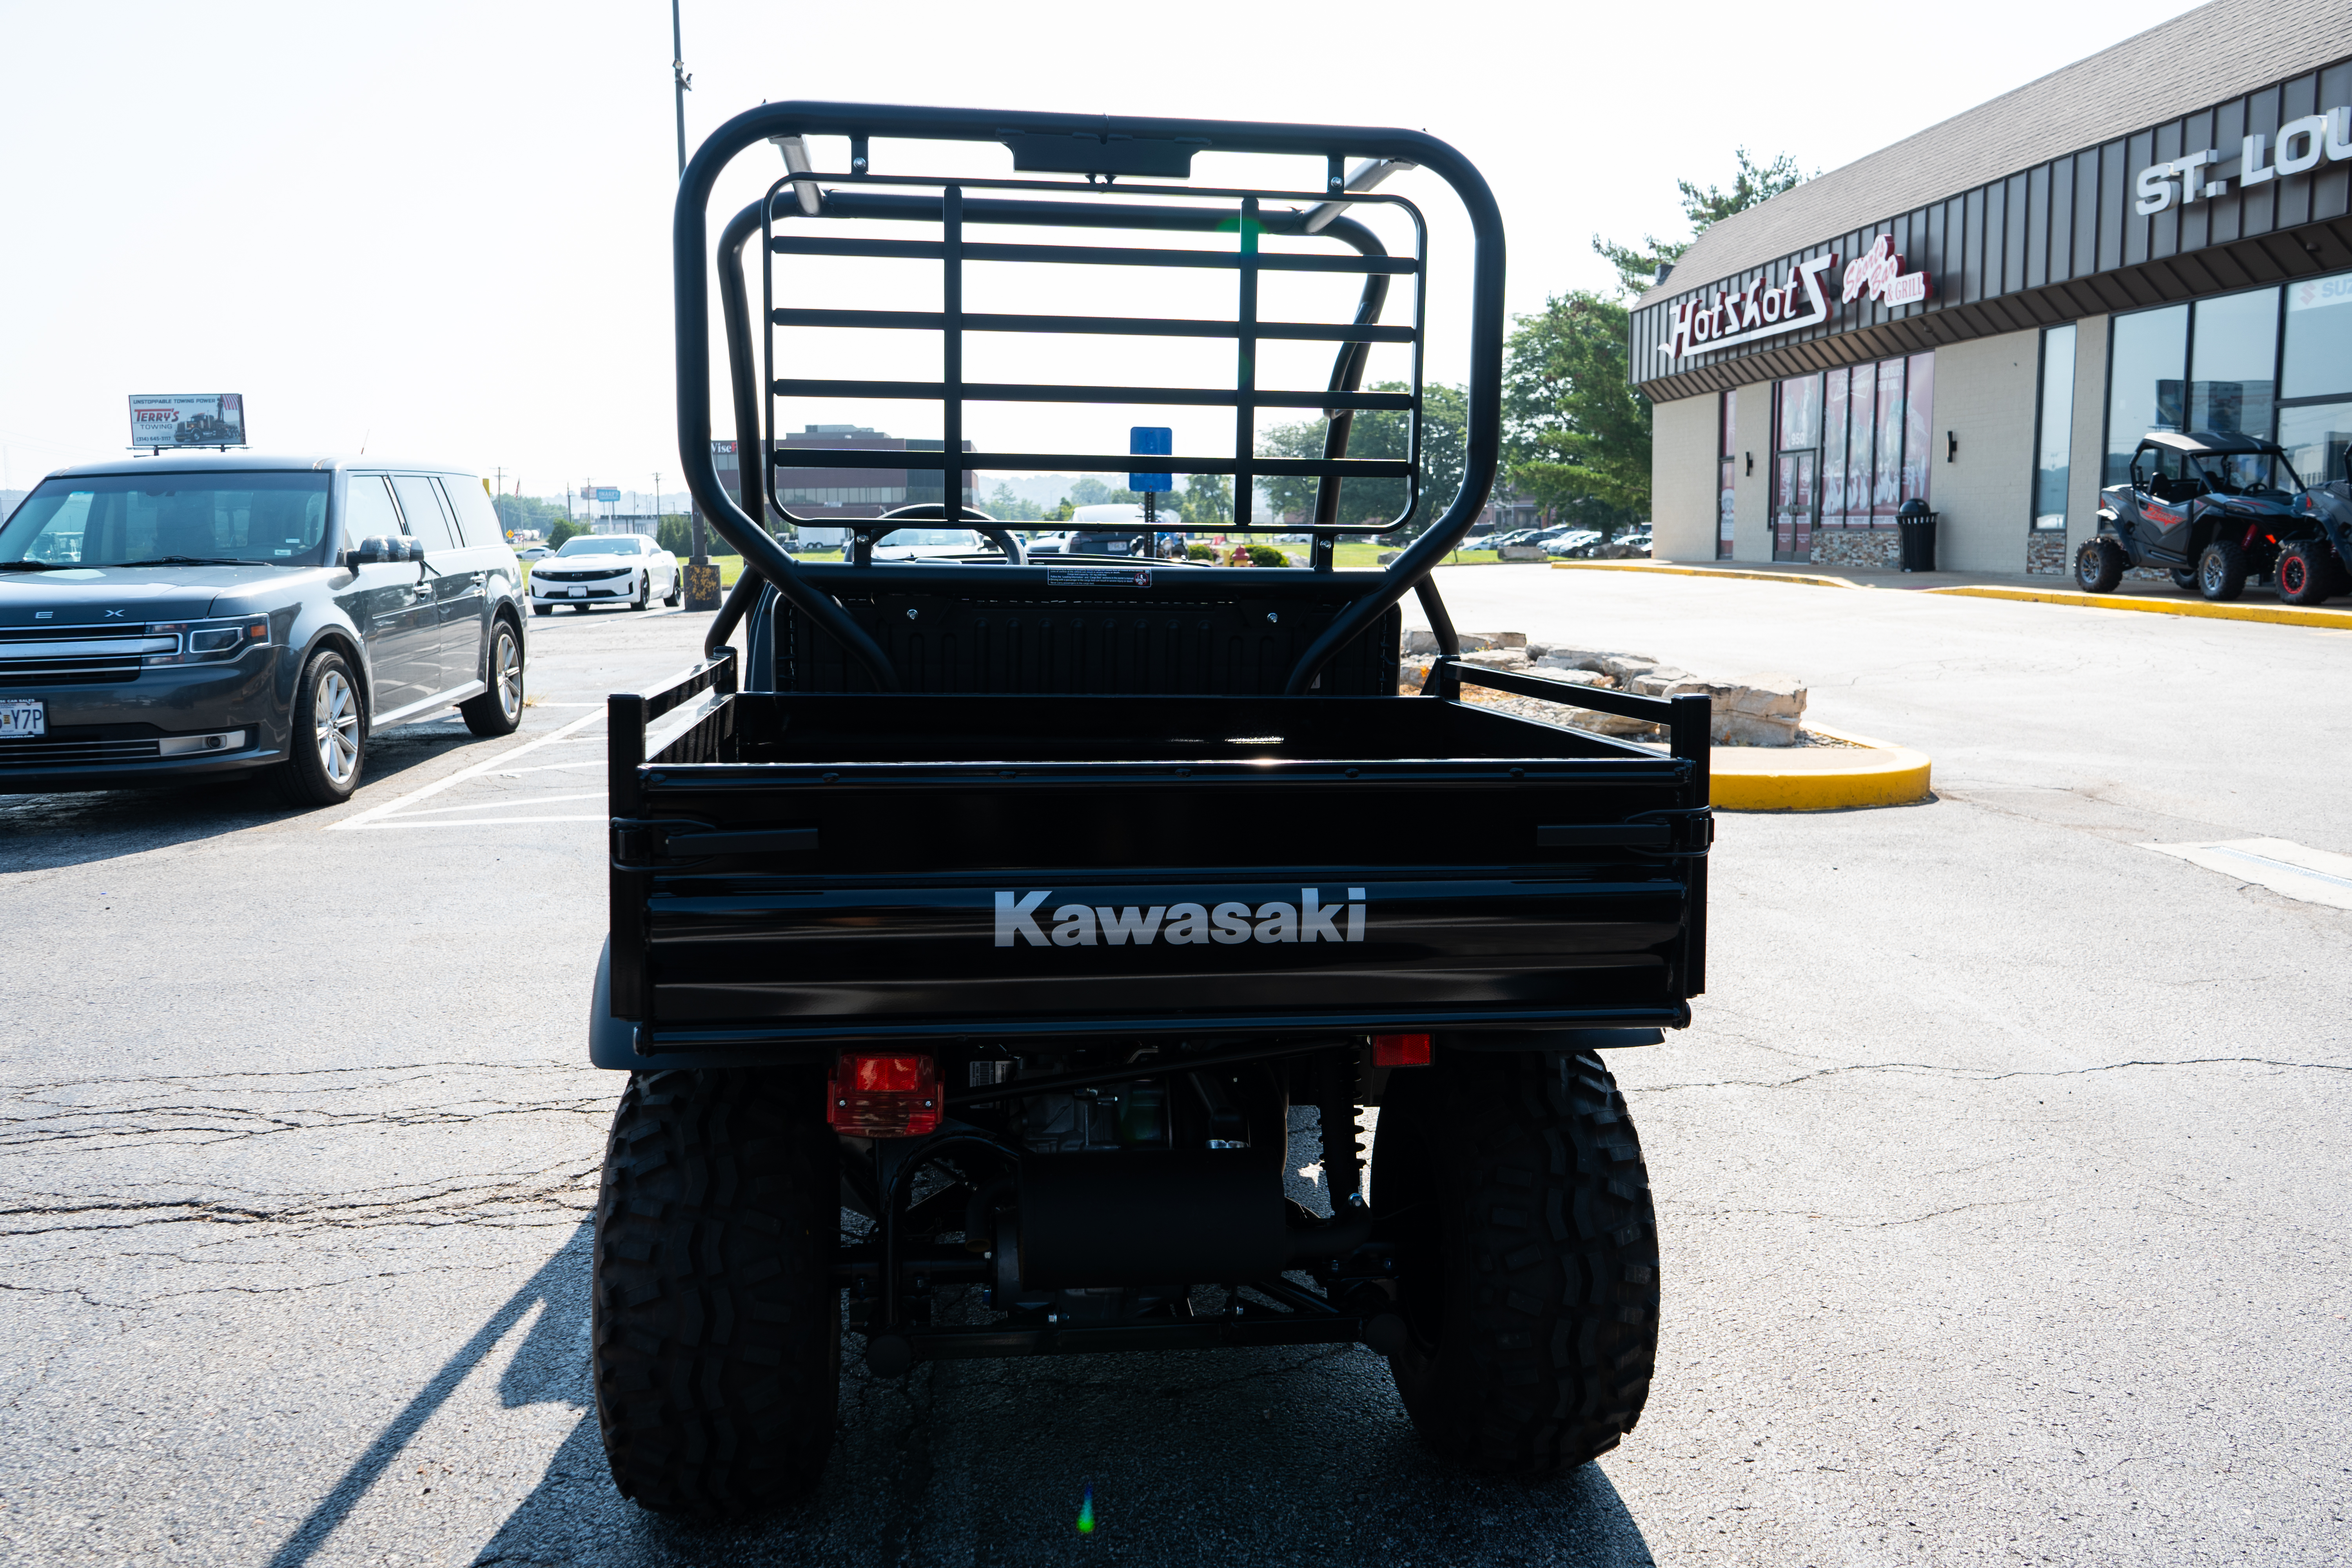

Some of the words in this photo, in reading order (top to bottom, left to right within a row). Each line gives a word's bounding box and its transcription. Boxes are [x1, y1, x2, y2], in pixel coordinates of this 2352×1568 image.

[2136, 149, 2224, 216] ST.
[1845, 240, 1885, 298] Sports
[1871, 260, 1895, 295] Bar
[1887, 284, 1893, 302] &
[1895, 276, 1923, 300] GRILL
[1878, 367, 1889, 378] THIS
[134, 408, 180, 422] TERRY'S
[1791, 433, 1804, 445] 950
[995, 887, 1366, 947] Kawasaki
